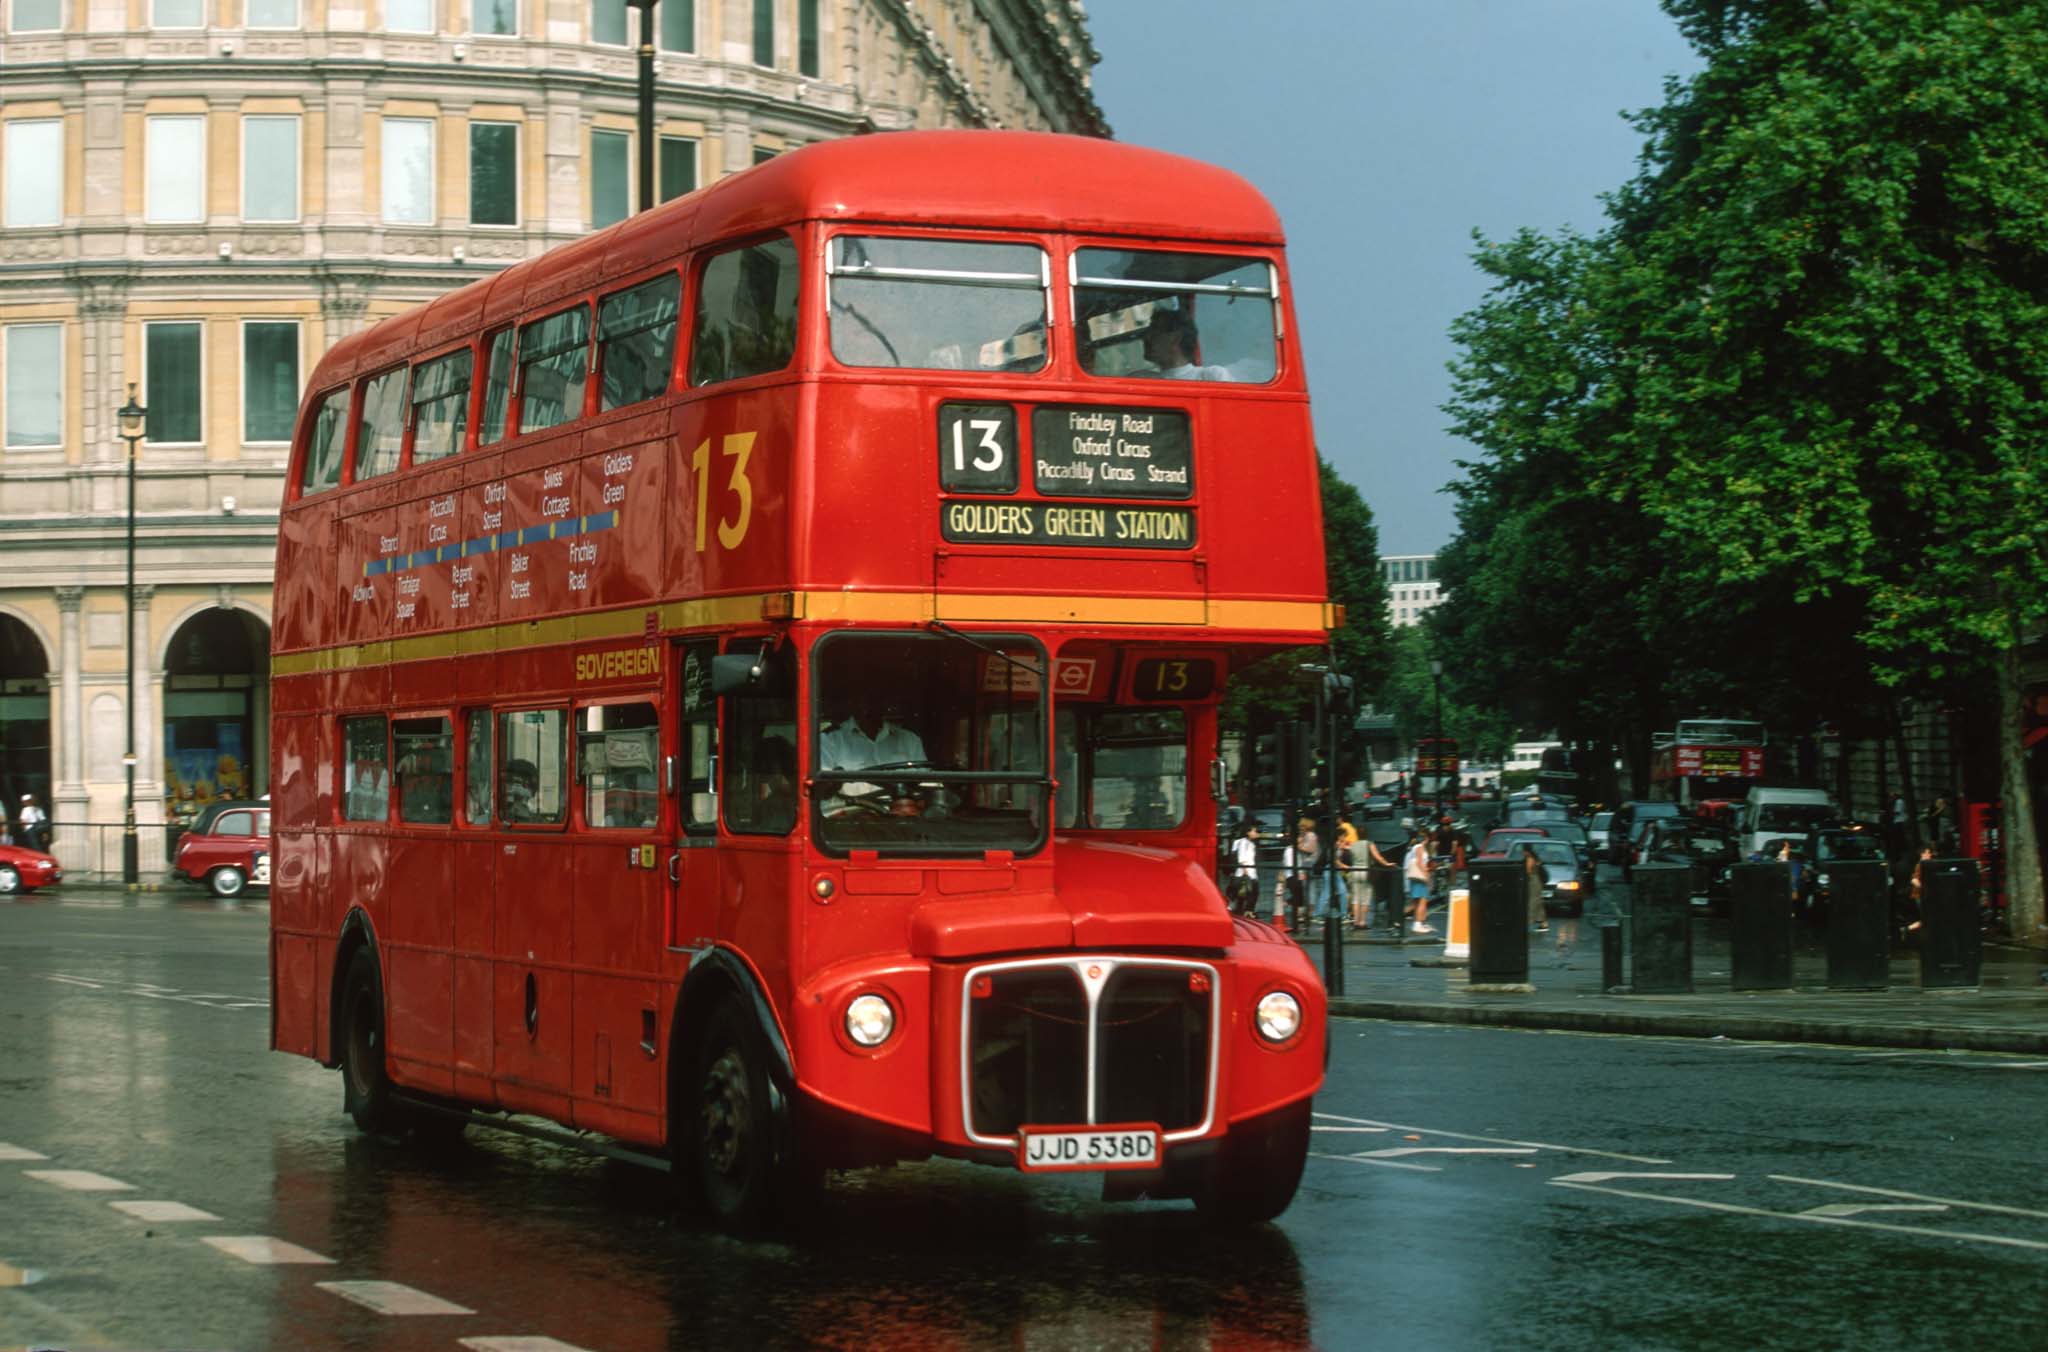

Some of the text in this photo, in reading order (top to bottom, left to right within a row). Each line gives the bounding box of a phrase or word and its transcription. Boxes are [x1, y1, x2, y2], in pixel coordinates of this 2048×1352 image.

[1069, 412, 1153, 437] Finchley Road
[952, 419, 1004, 472] 13
[1072, 436, 1152, 458] Oxford Circus
[603, 452, 633, 477] Golders
[1036, 459, 1187, 485] Piccadilly Circus Strand
[543, 468, 563, 490] Swiss
[484, 481, 507, 505] Oxford
[602, 482, 625, 505] Green
[692, 431, 758, 552] 13
[541, 495, 570, 518] Cottage
[482, 510, 502, 531] Street
[950, 504, 1189, 541] GOLDERS GREEN STATION
[511, 551, 529, 574] Baker
[510, 580, 531, 600] Street
[568, 568, 588, 591] Road
[576, 646, 660, 681] SOVEREIGN
[1156, 661, 1189, 692] 13
[1030, 1135, 1154, 1160] JJD 538D
